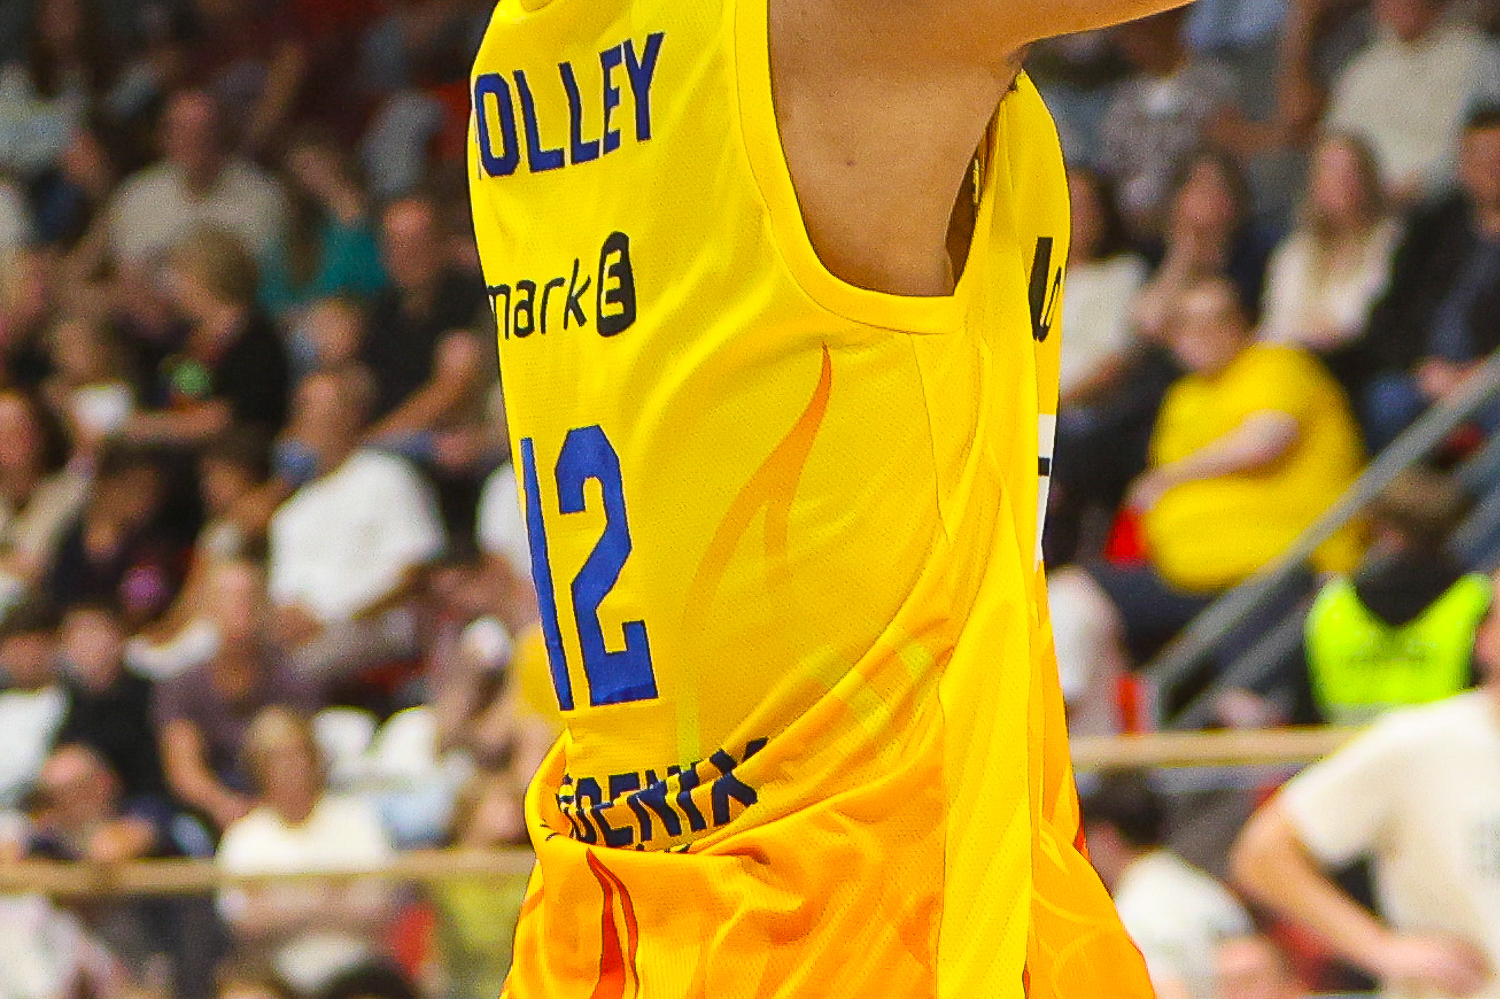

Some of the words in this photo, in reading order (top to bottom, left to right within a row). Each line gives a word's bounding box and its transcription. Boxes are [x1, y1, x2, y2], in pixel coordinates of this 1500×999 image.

[475, 30, 666, 179] OLLEY
[519, 424, 659, 712] 12
[556, 737, 770, 848] OENIX
